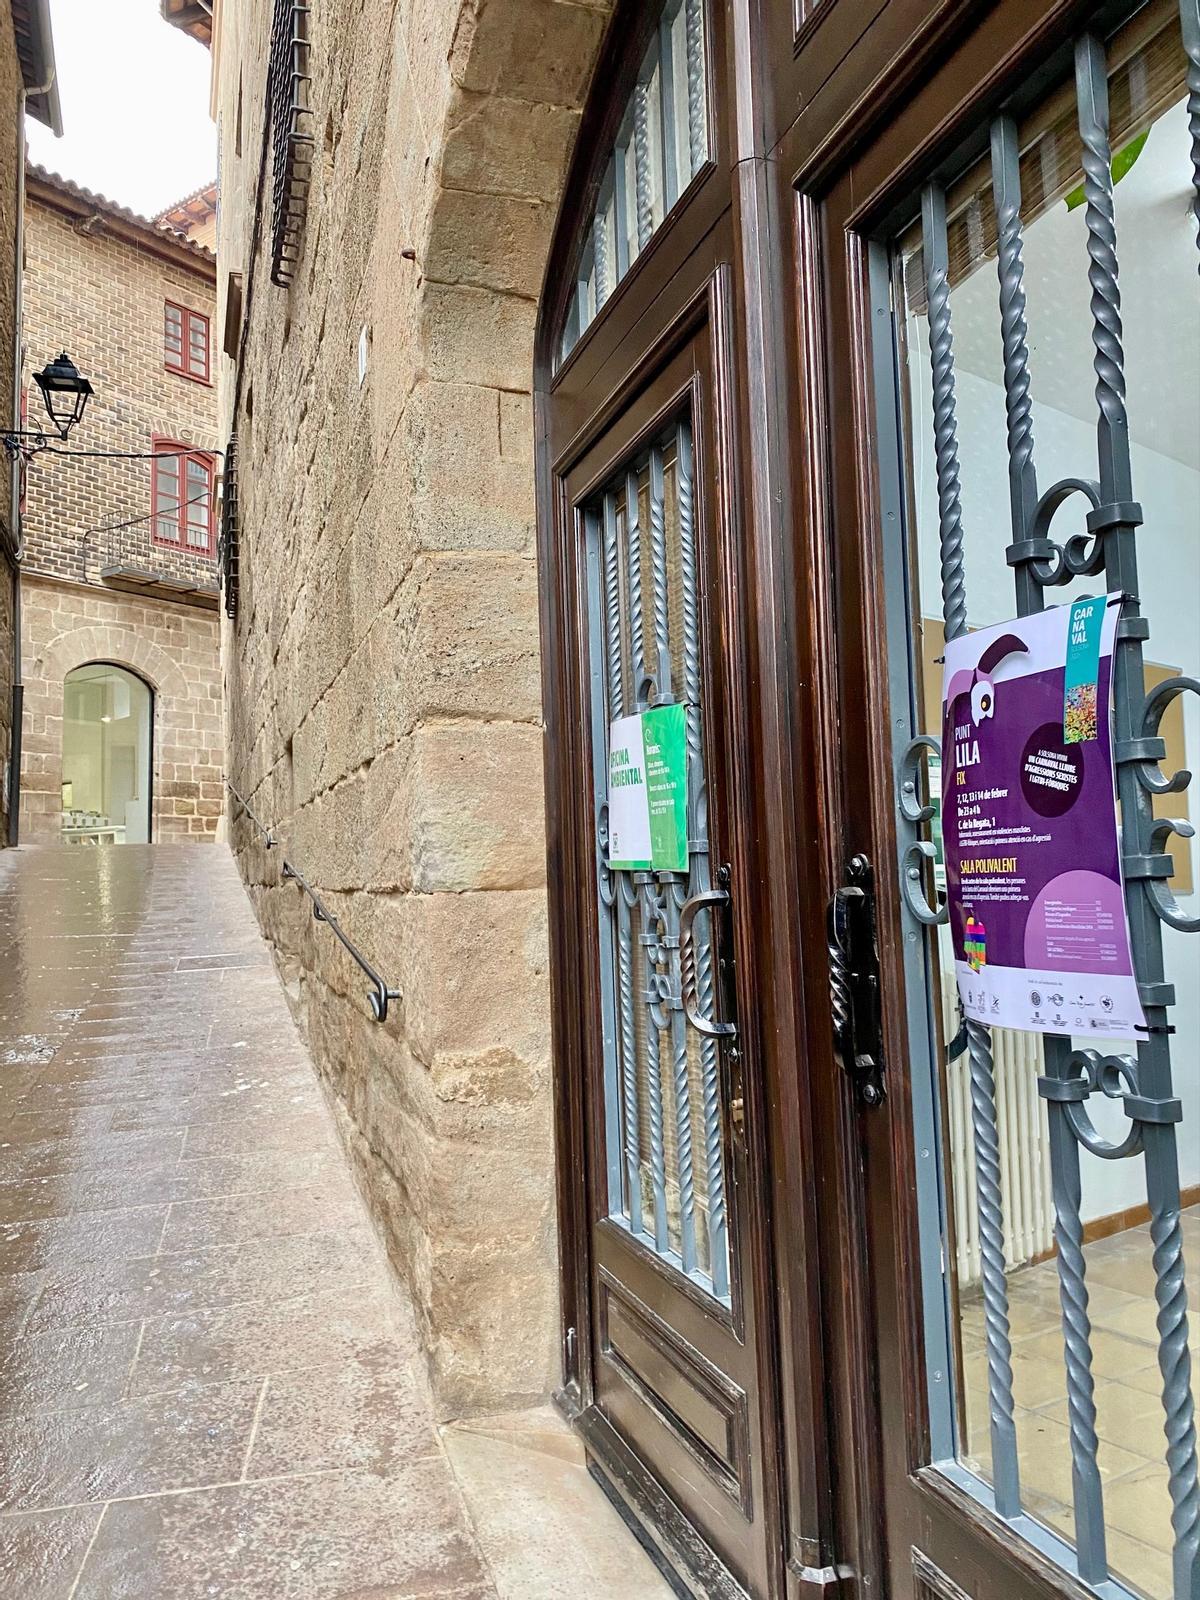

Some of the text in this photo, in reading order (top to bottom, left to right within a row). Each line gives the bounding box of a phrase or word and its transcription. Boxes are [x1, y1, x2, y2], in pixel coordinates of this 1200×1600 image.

[1073, 606, 1094, 621] CAR
[1072, 619, 1086, 633] NA
[1071, 631, 1088, 645] VAL
[955, 723, 971, 741] PUNT
[955, 740, 981, 768] LILA
[956, 770, 966, 786] FIX
[977, 791, 984, 801] 14
[984, 789, 991, 800] de
[991, 787, 1009, 799] febrer
[963, 806, 969, 816] 23
[960, 857, 1018, 874] SALA POLIVALENT
